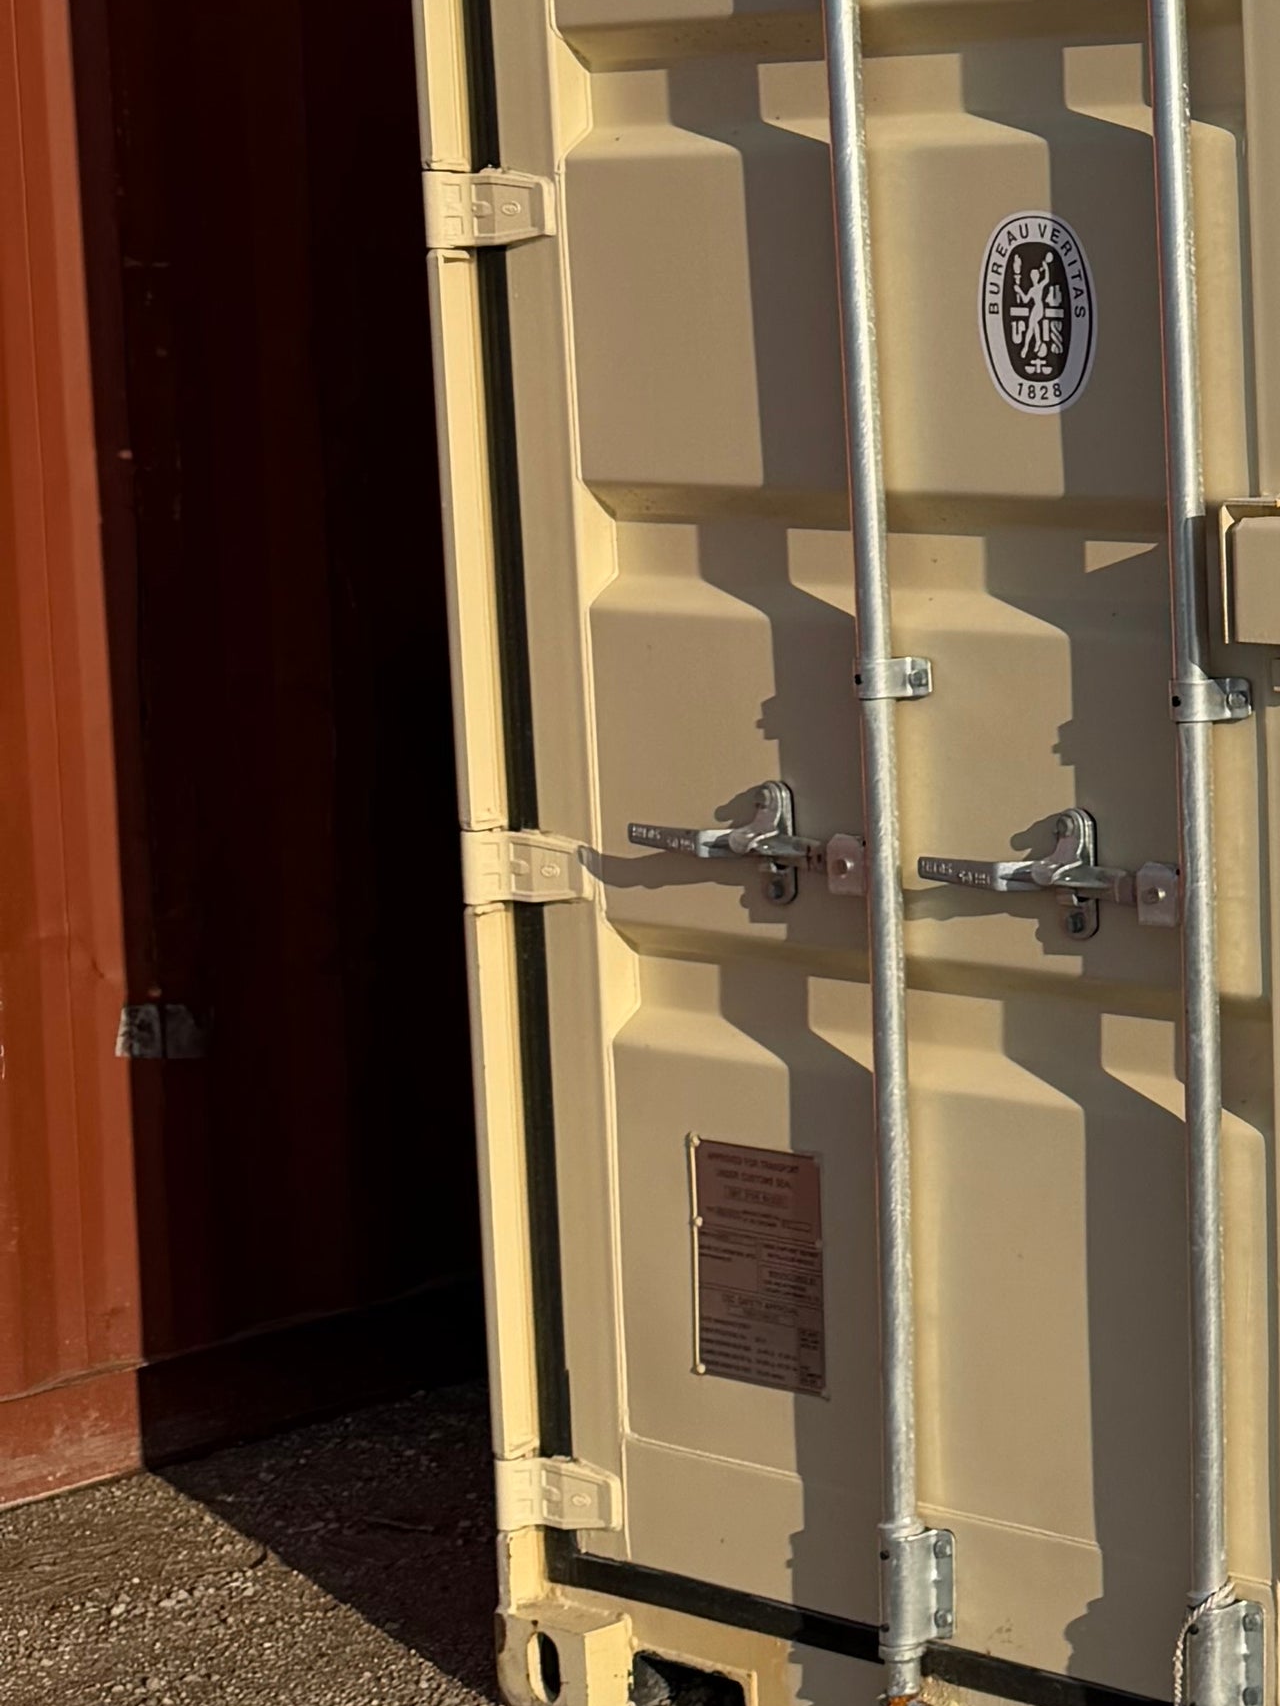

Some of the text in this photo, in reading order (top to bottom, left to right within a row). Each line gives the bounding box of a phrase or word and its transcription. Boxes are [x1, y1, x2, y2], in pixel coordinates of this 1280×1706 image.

[988, 222, 1086, 319] BUREAU VERITAS
[1016, 382, 1063, 401] 1828
